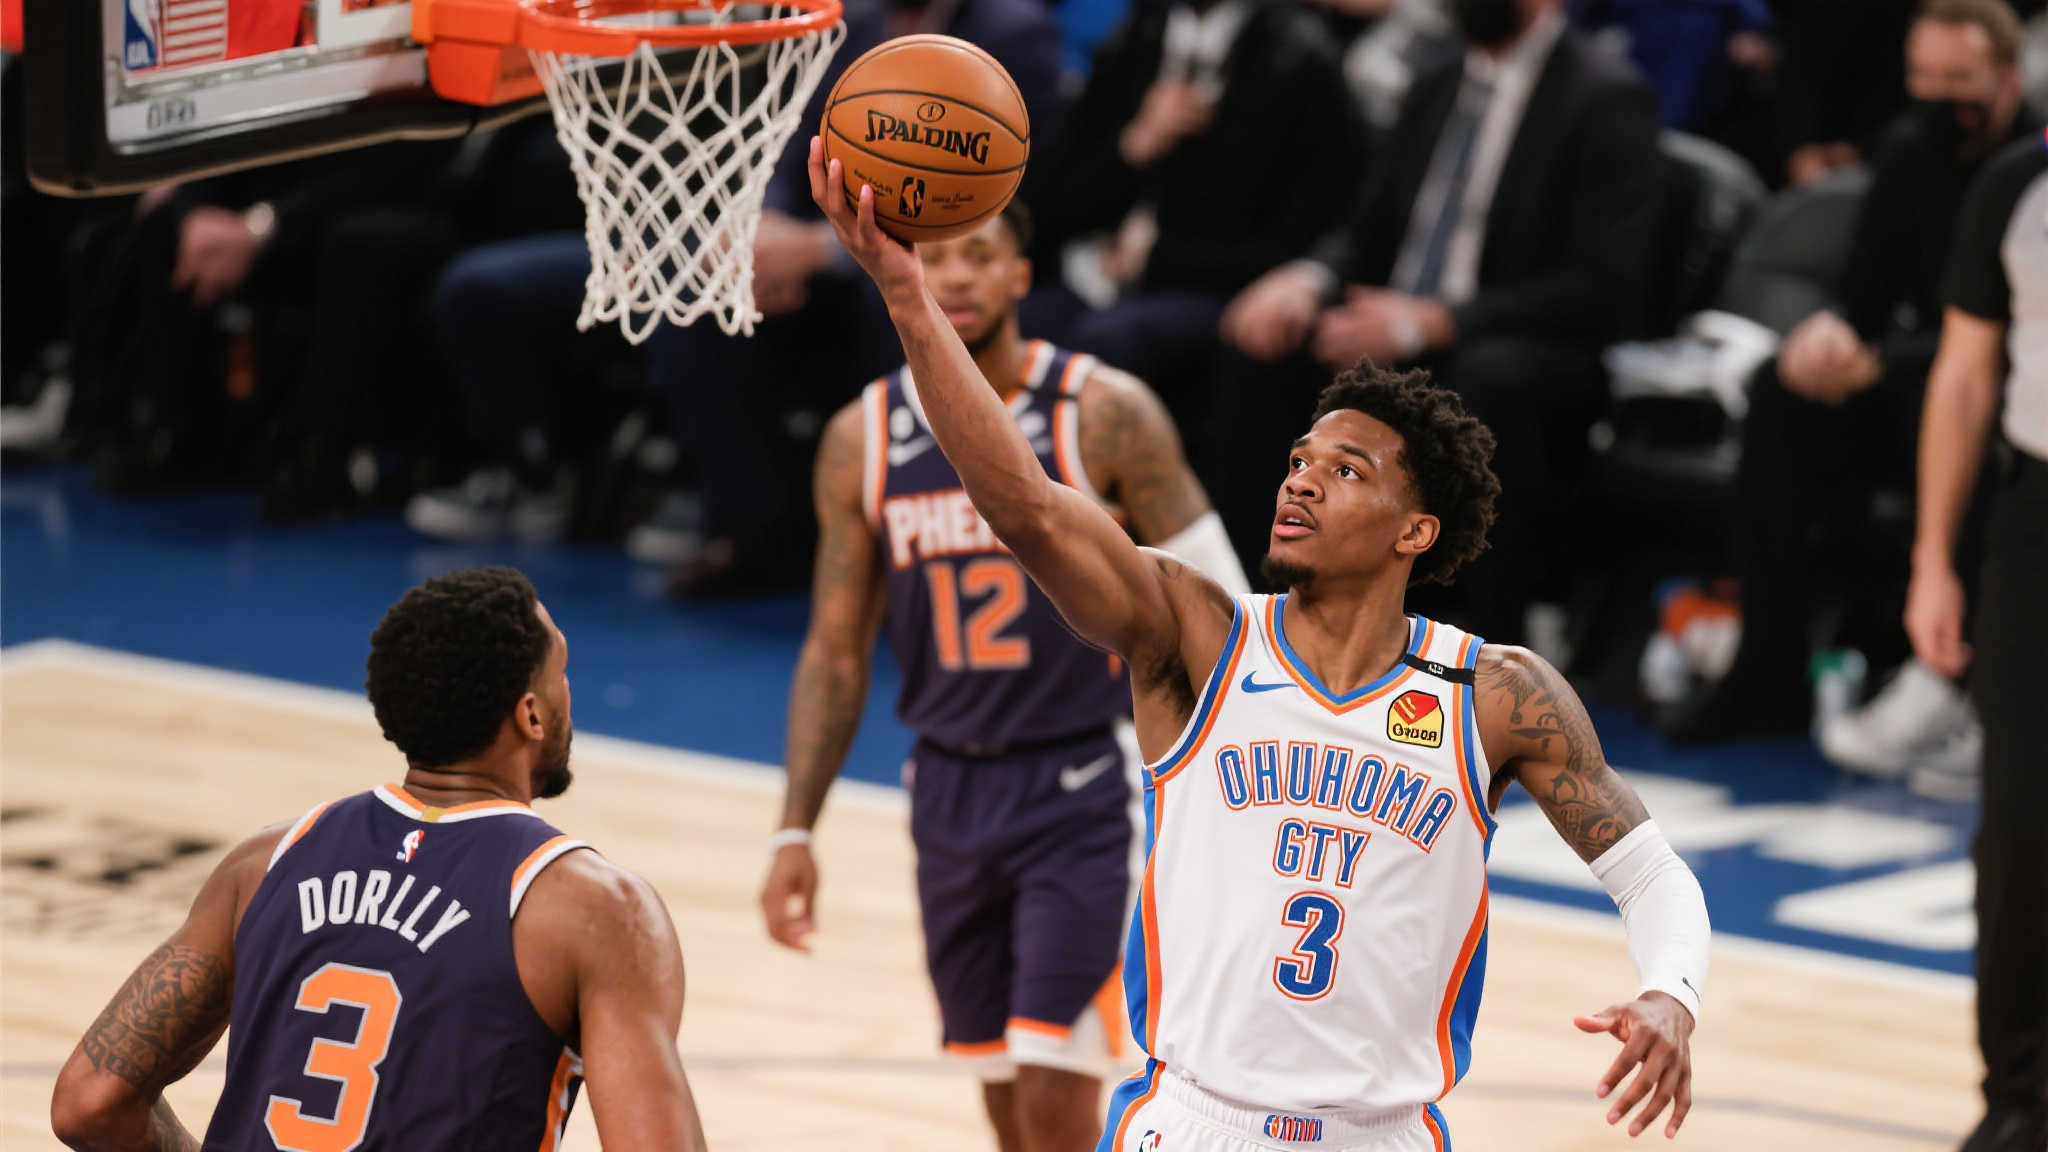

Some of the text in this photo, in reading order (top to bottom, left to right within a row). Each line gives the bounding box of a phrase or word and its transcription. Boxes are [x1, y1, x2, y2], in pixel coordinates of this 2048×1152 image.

[865, 109, 991, 166] SPALDING
[927, 558, 1031, 671] 12
[298, 869, 471, 953] DORLLY
[1273, 891, 1345, 1002] 3
[264, 962, 403, 1152] 3
